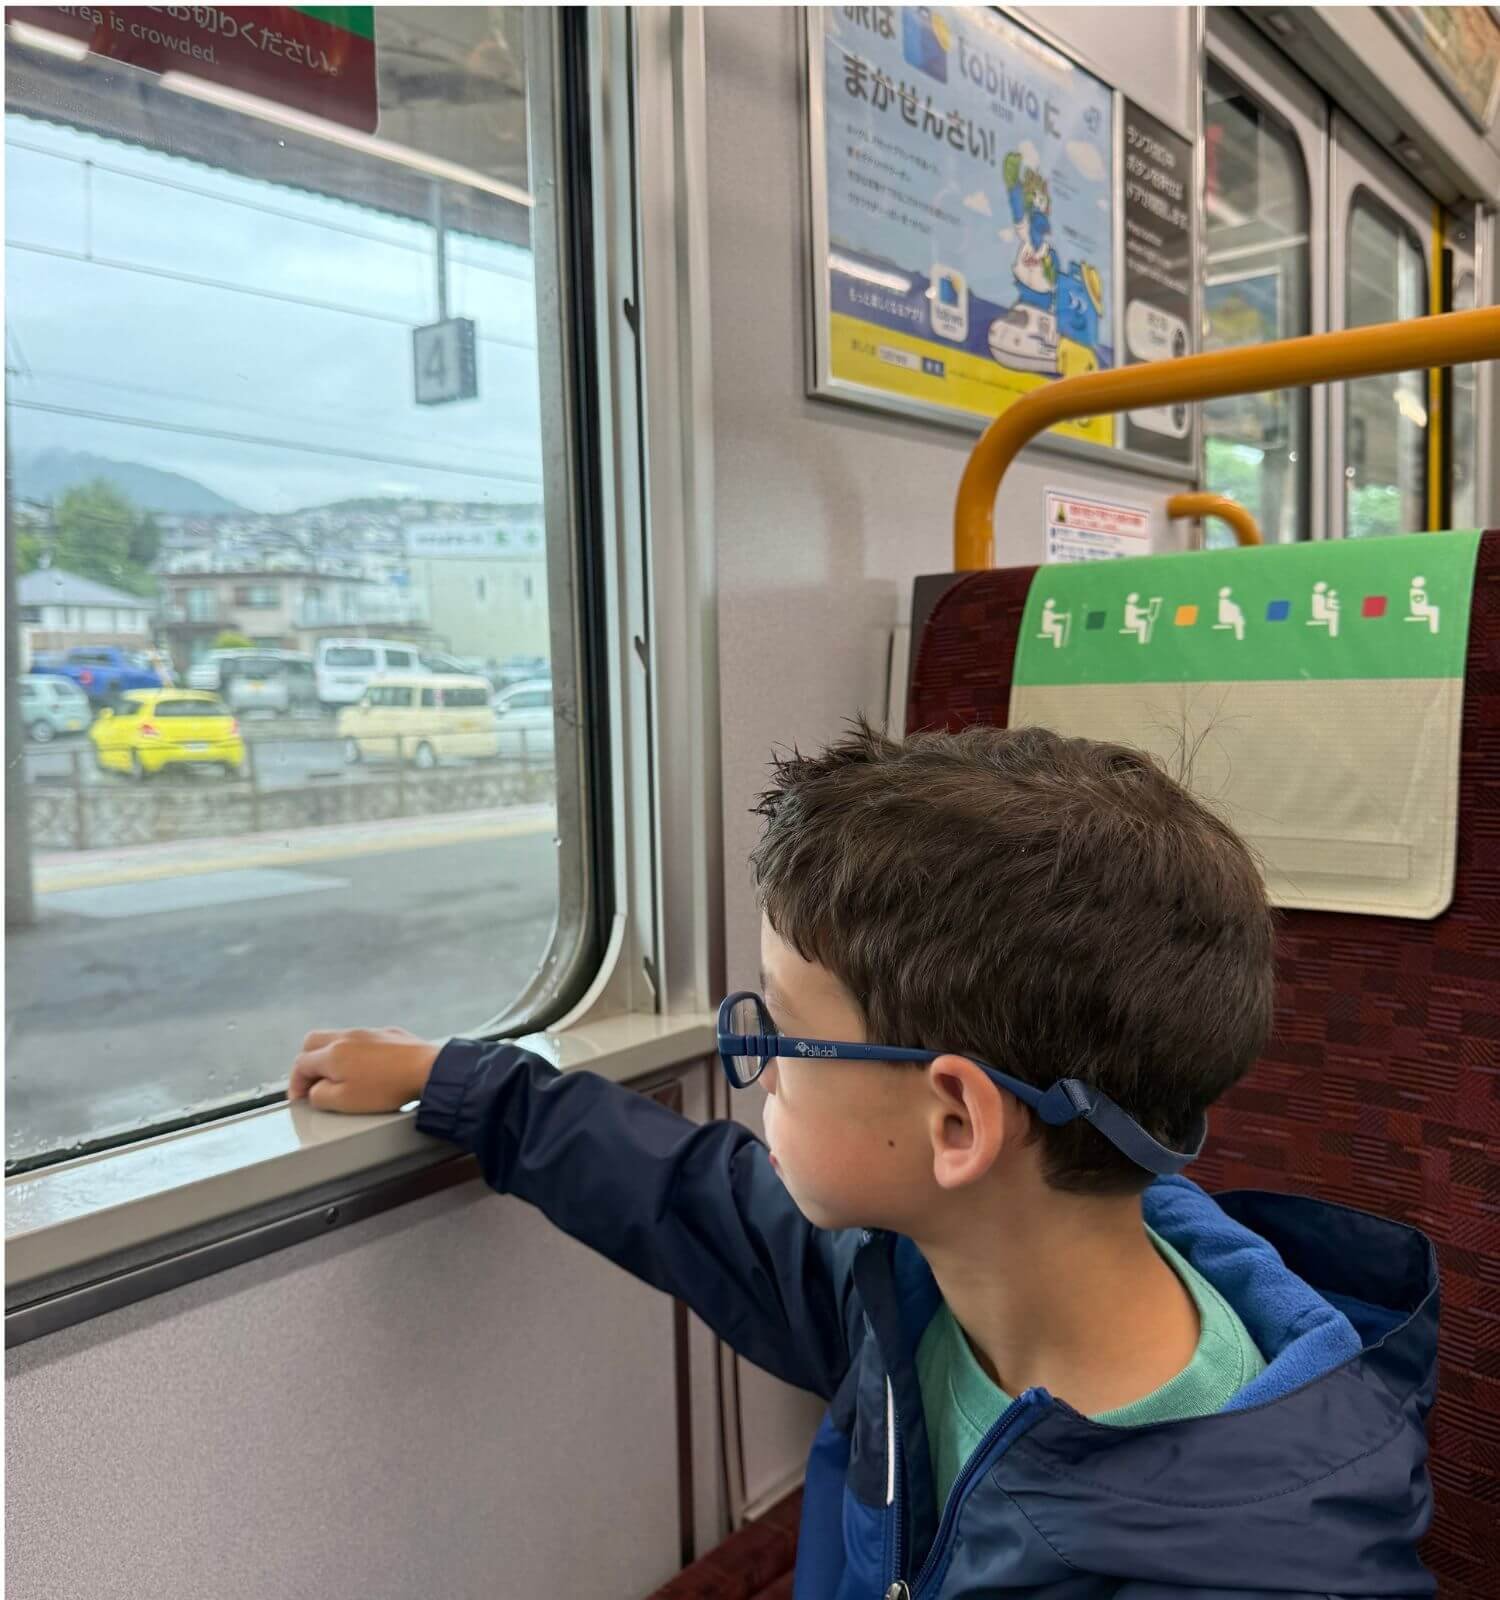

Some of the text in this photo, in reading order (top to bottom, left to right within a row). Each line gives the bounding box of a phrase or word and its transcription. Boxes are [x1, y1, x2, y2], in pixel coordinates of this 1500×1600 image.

[110, 10, 125, 32] is
[131, 23, 219, 65] crowded.
[424, 336, 446, 388] 4
